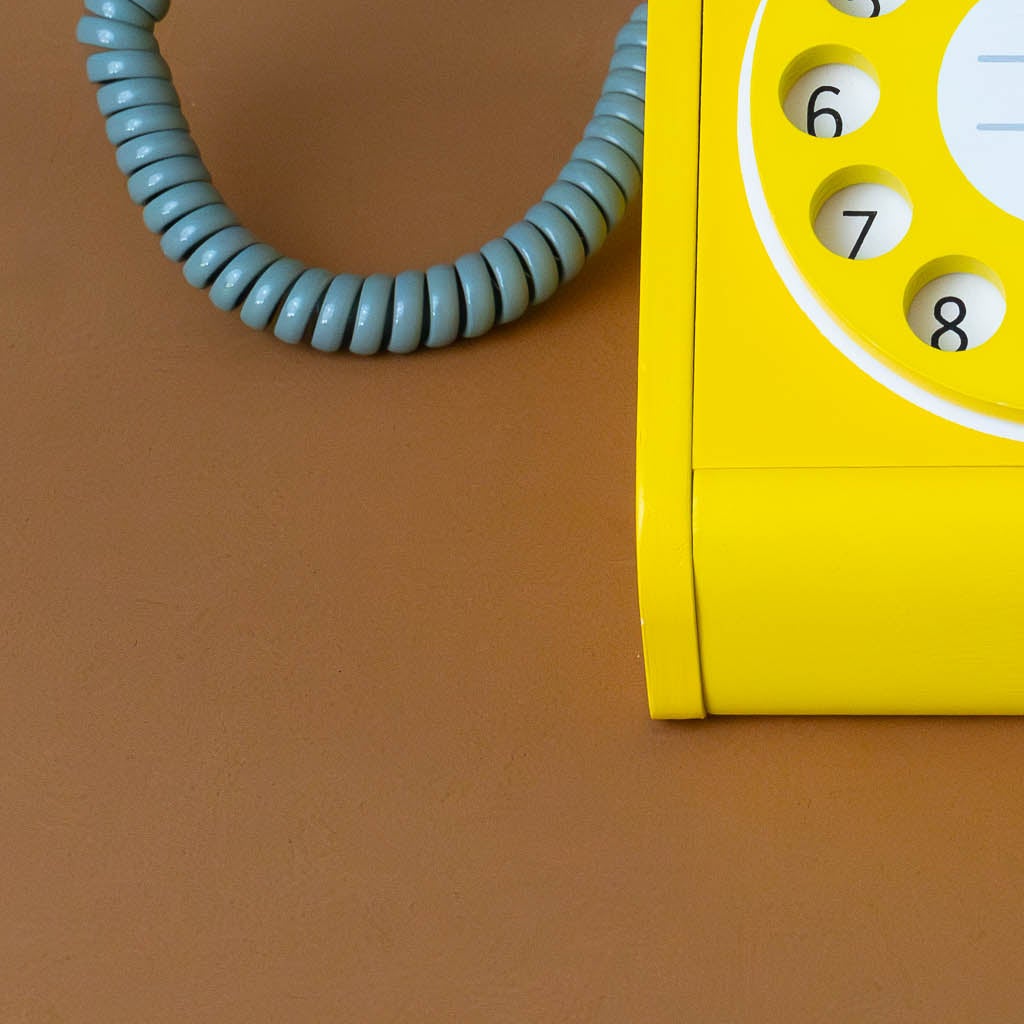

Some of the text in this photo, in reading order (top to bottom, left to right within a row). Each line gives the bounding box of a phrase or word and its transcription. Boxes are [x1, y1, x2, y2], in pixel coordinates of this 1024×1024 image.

[806, 85, 843, 138] 6
[842, 210, 878, 260] 7
[930, 296, 969, 352] 8
